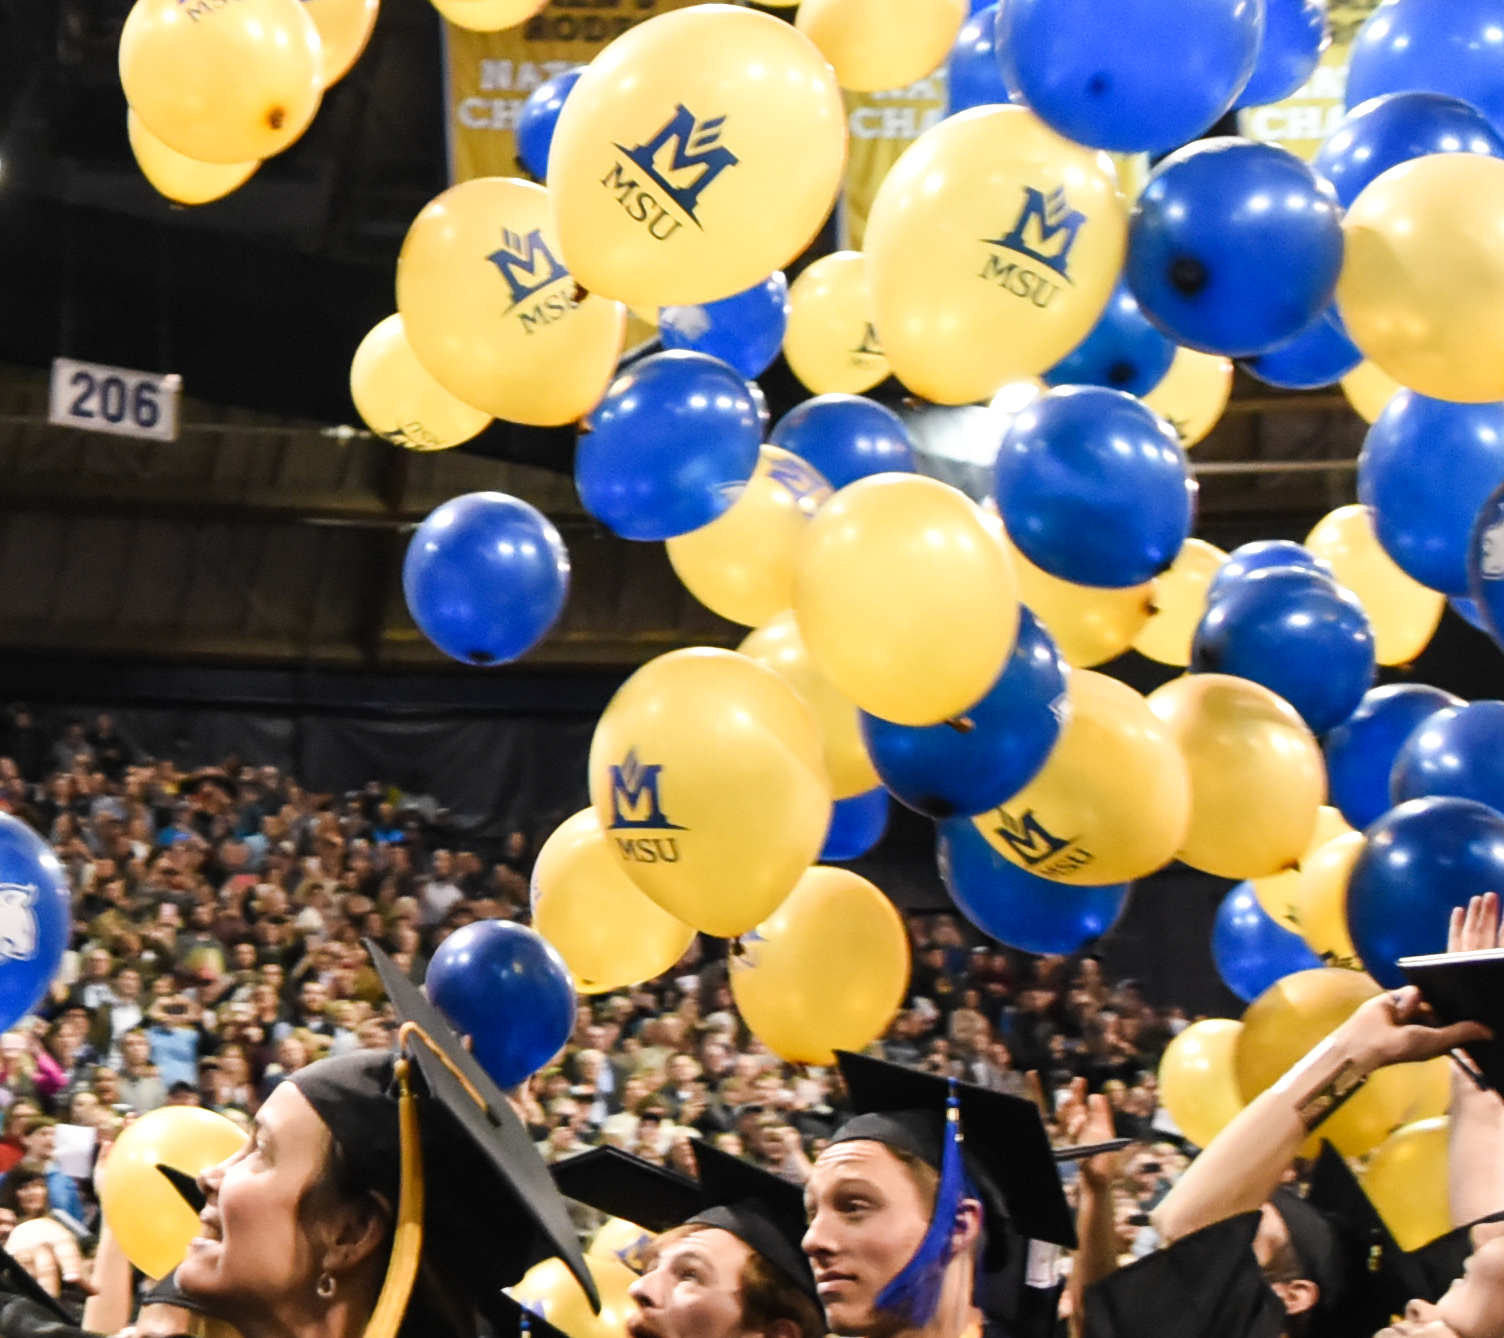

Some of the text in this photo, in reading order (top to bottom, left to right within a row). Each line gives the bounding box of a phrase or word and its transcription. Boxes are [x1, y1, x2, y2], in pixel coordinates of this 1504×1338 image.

[600, 160, 683, 241] MSU
[977, 252, 1062, 308] MSU
[69, 370, 162, 429] 206
[613, 837, 679, 863] MSU
